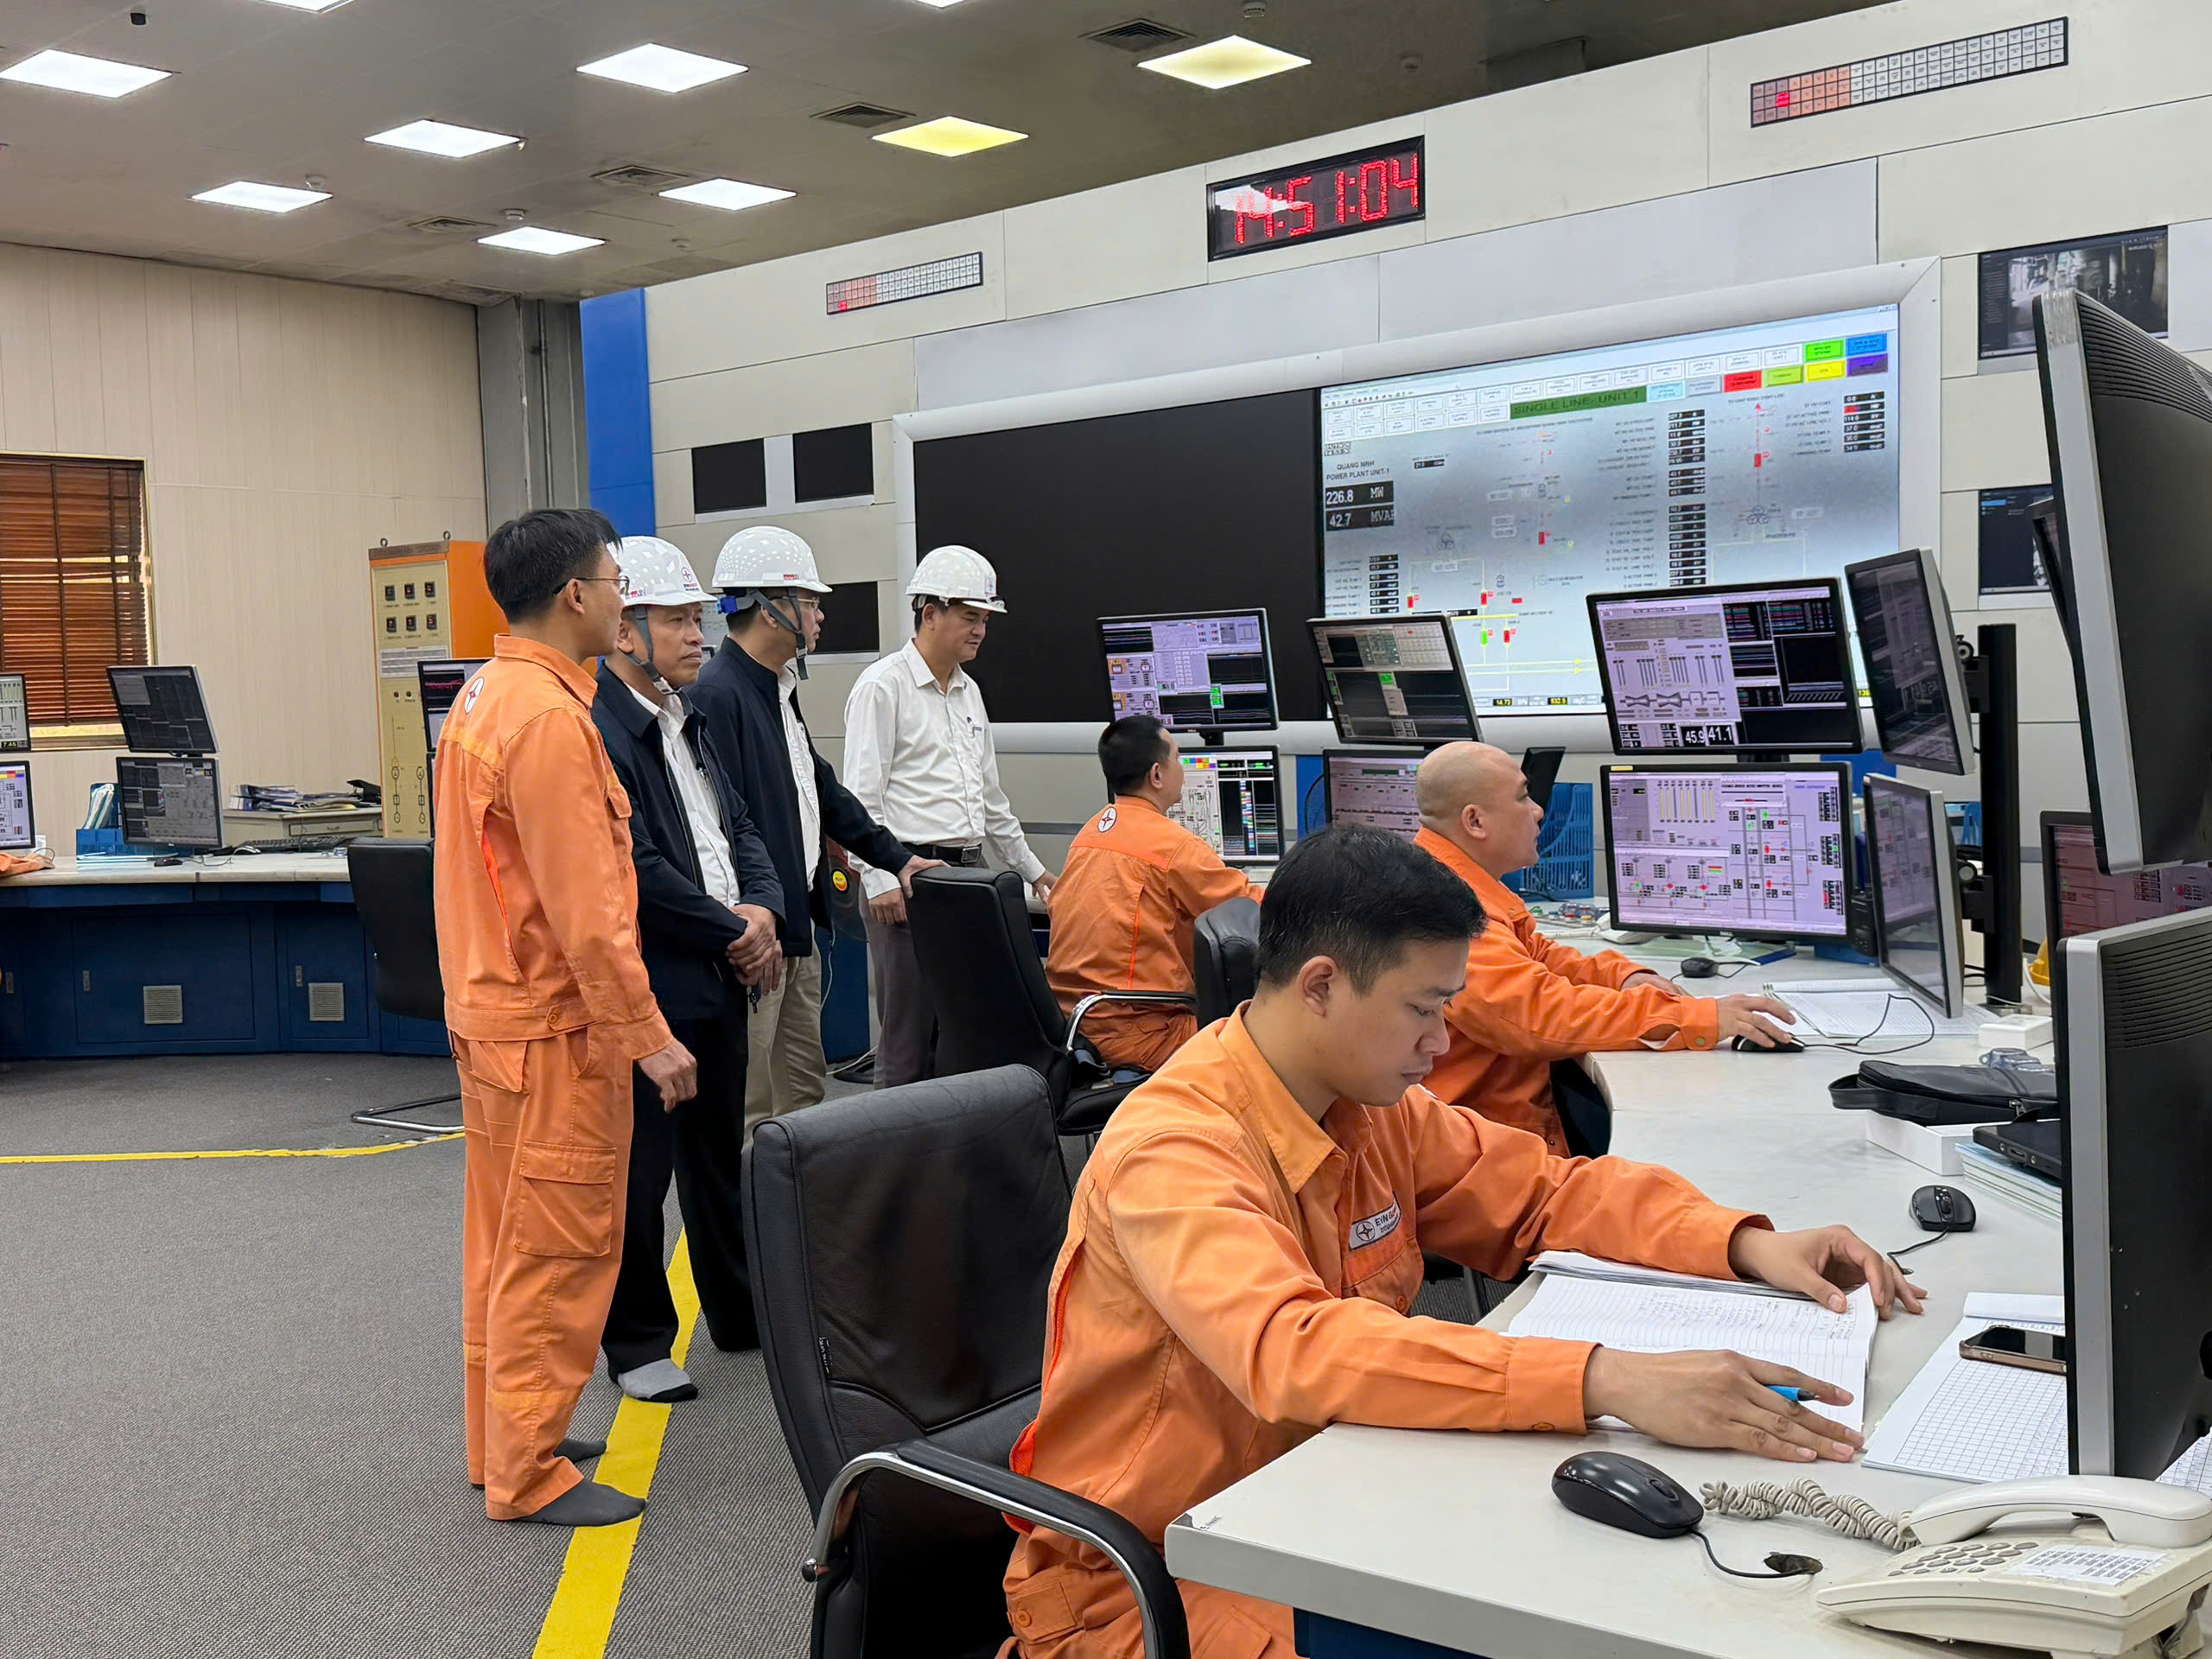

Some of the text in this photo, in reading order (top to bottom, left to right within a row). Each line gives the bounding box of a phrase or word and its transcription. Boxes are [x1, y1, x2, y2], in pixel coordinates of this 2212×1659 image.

[1236, 153, 1418, 245] 14:51:04
[1514, 402, 1557, 415] SINGLE
[1599, 391, 1628, 404] UNIT
[1326, 486, 1384, 505] 226.8 MW
[1329, 512, 1351, 528] 42.7
[1685, 730, 1706, 744] 45.9
[1707, 726, 1732, 741] 41.1
